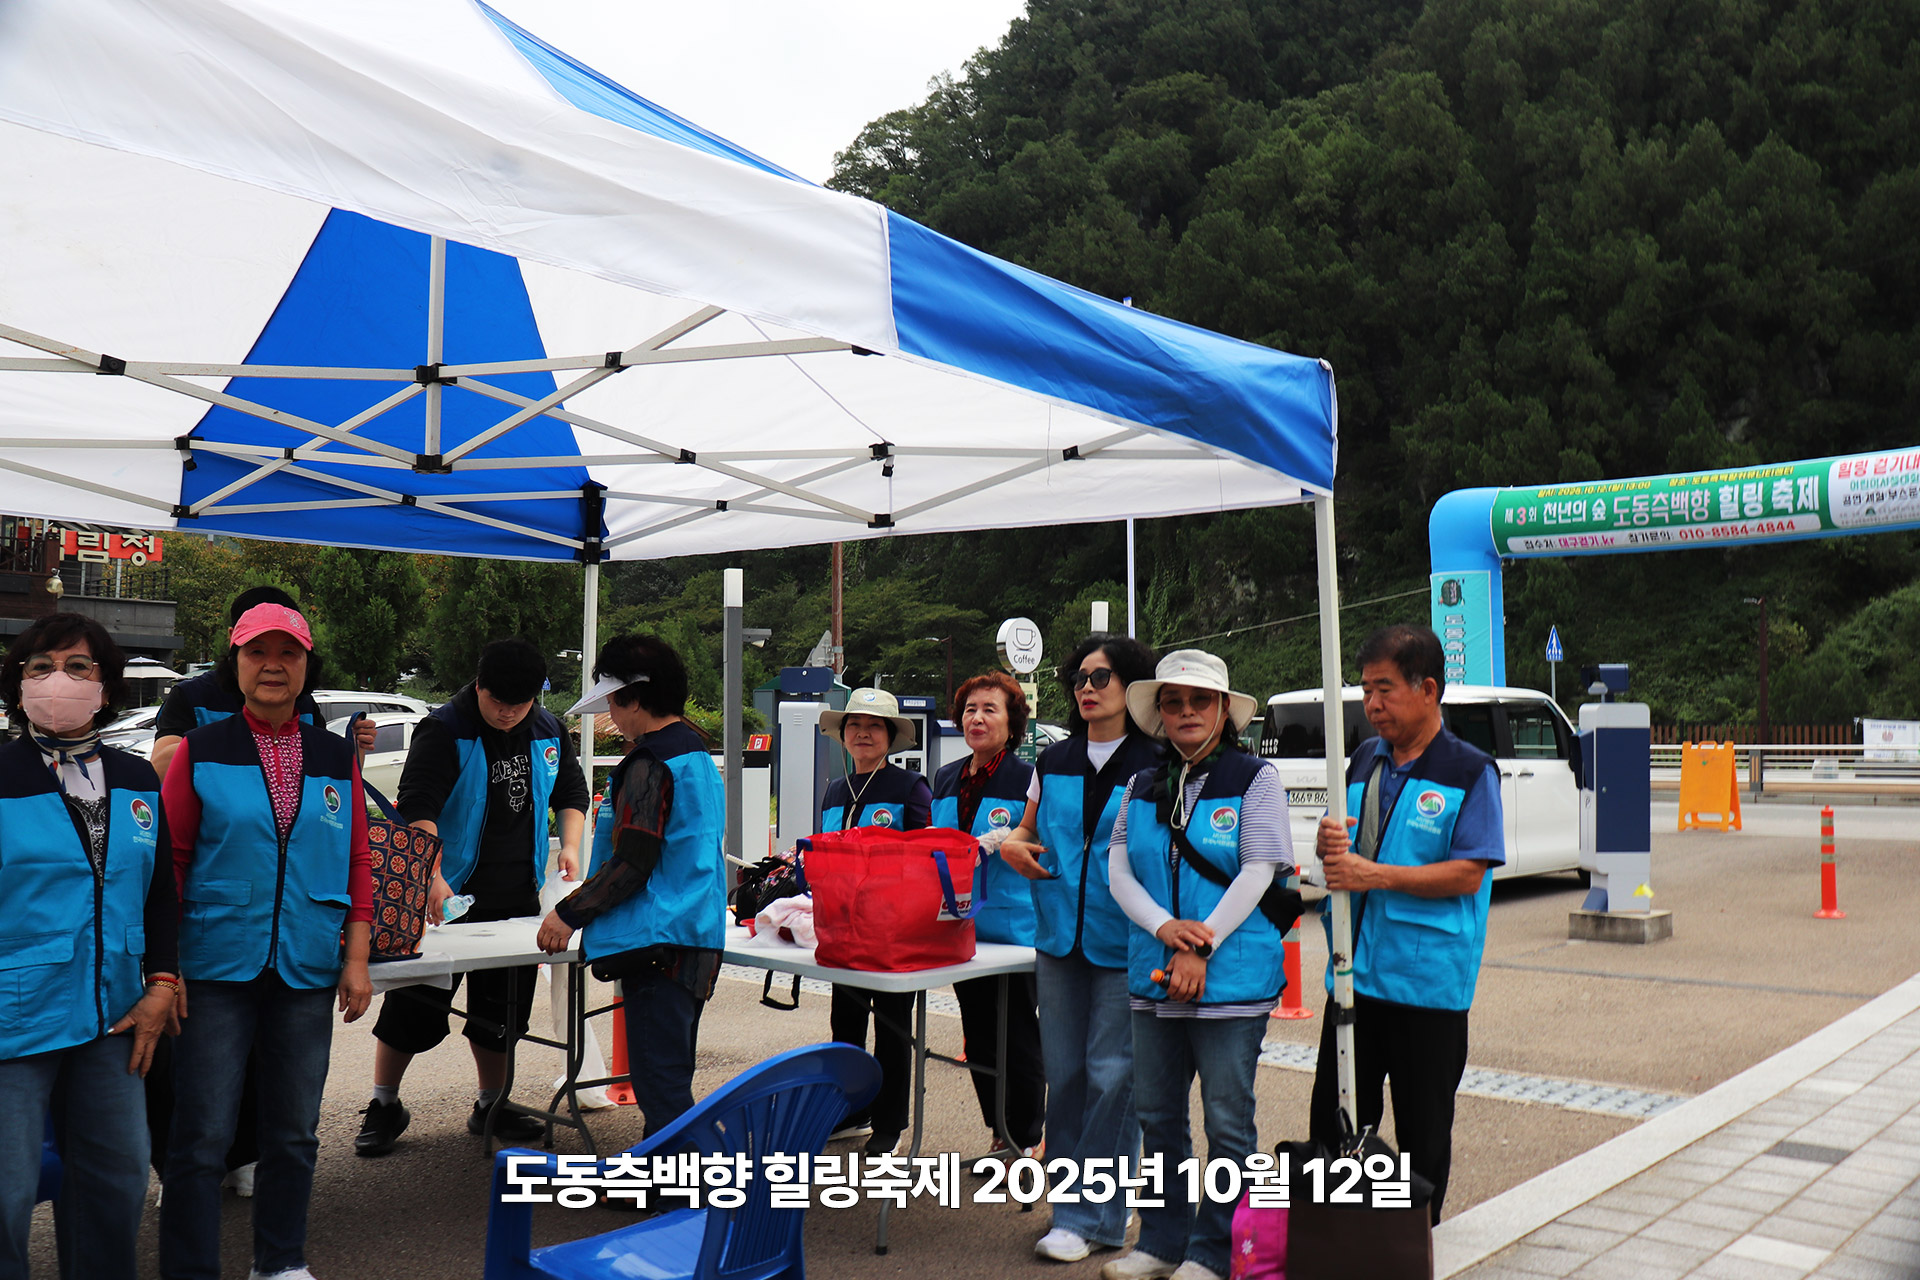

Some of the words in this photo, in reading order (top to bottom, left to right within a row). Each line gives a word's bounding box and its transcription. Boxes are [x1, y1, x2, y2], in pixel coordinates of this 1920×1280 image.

[1838, 459, 1868, 479] 힐링
[1543, 499, 1586, 525] 천년의
[1591, 498, 1606, 522] 숲
[1613, 489, 1711, 526] 도동측백향
[1718, 481, 1764, 520] 힐링
[1771, 475, 1819, 514] 축제
[1013, 654, 1036, 665] Coffee
